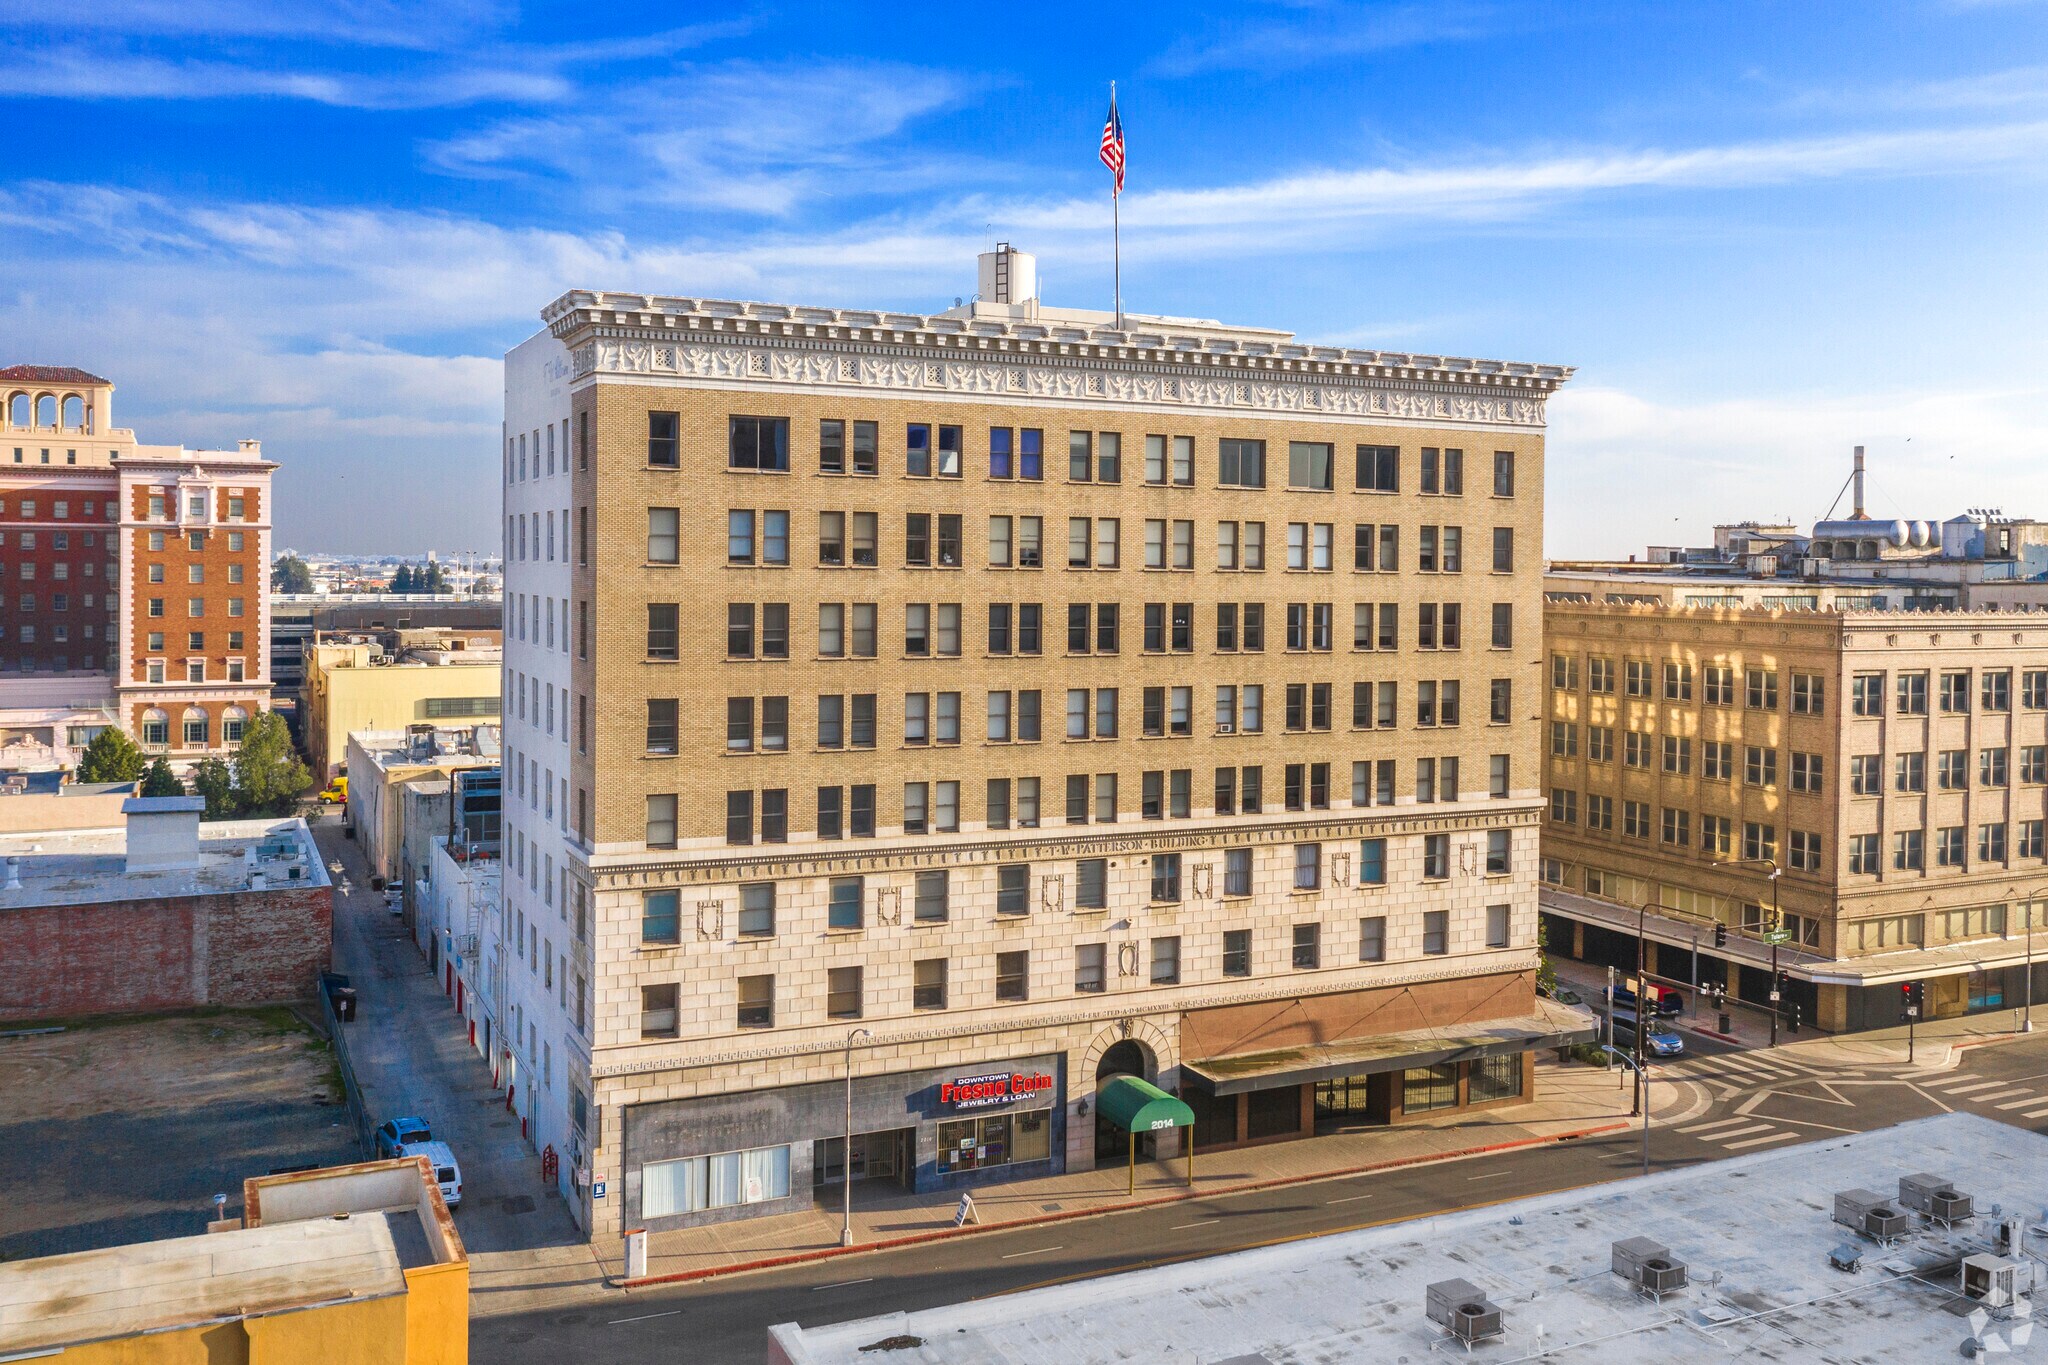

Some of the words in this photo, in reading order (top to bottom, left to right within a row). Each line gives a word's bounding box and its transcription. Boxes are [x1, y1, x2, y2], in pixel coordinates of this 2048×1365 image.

[958, 1073, 1009, 1085] DOWNTOWN
[941, 1080, 1006, 1103] Fresno
[1011, 1071, 1052, 1094] Coin
[957, 1096, 1001, 1108] JEWELRY
[1010, 1092, 1036, 1101] LOAN
[1151, 1118, 1174, 1130] 2014
